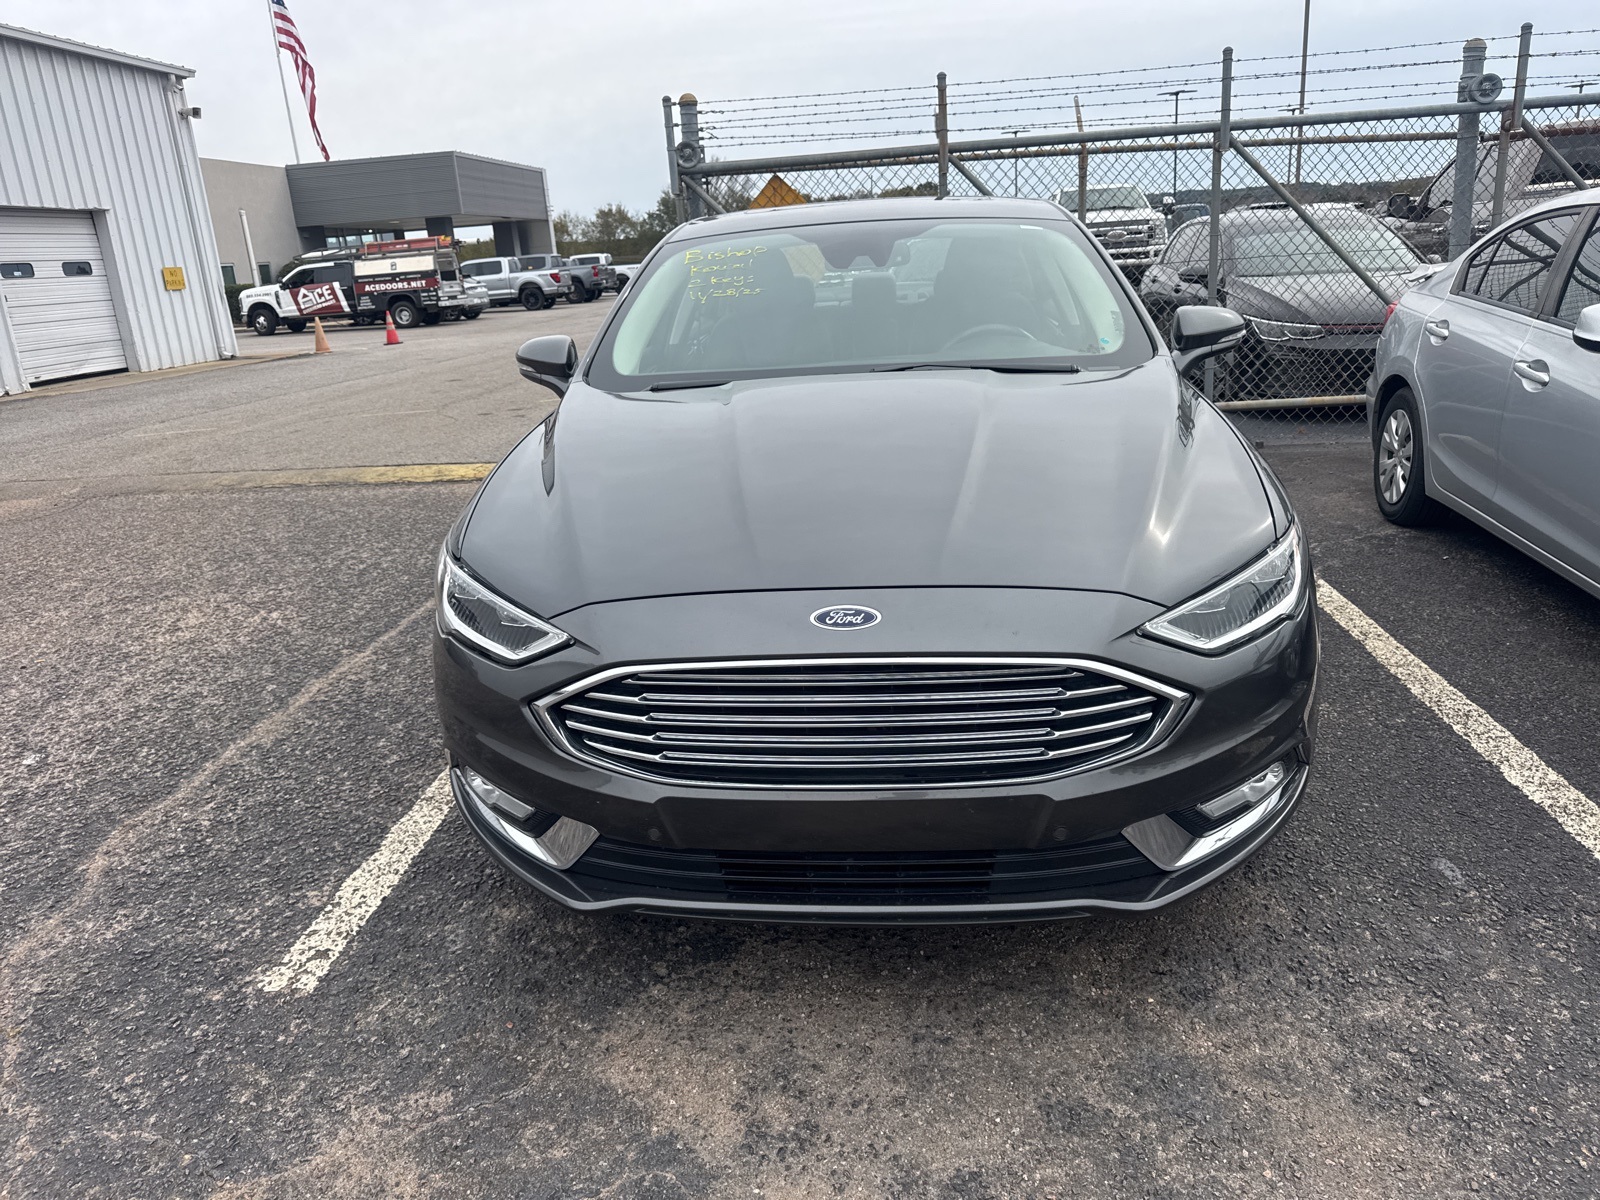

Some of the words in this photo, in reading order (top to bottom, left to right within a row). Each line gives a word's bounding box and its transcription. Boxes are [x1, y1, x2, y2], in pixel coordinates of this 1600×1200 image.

[169, 269, 178, 277] NO
[364, 279, 427, 292] ACEDOORS.NET
[297, 284, 334, 310] ACE
[825, 610, 865, 624] Ford
